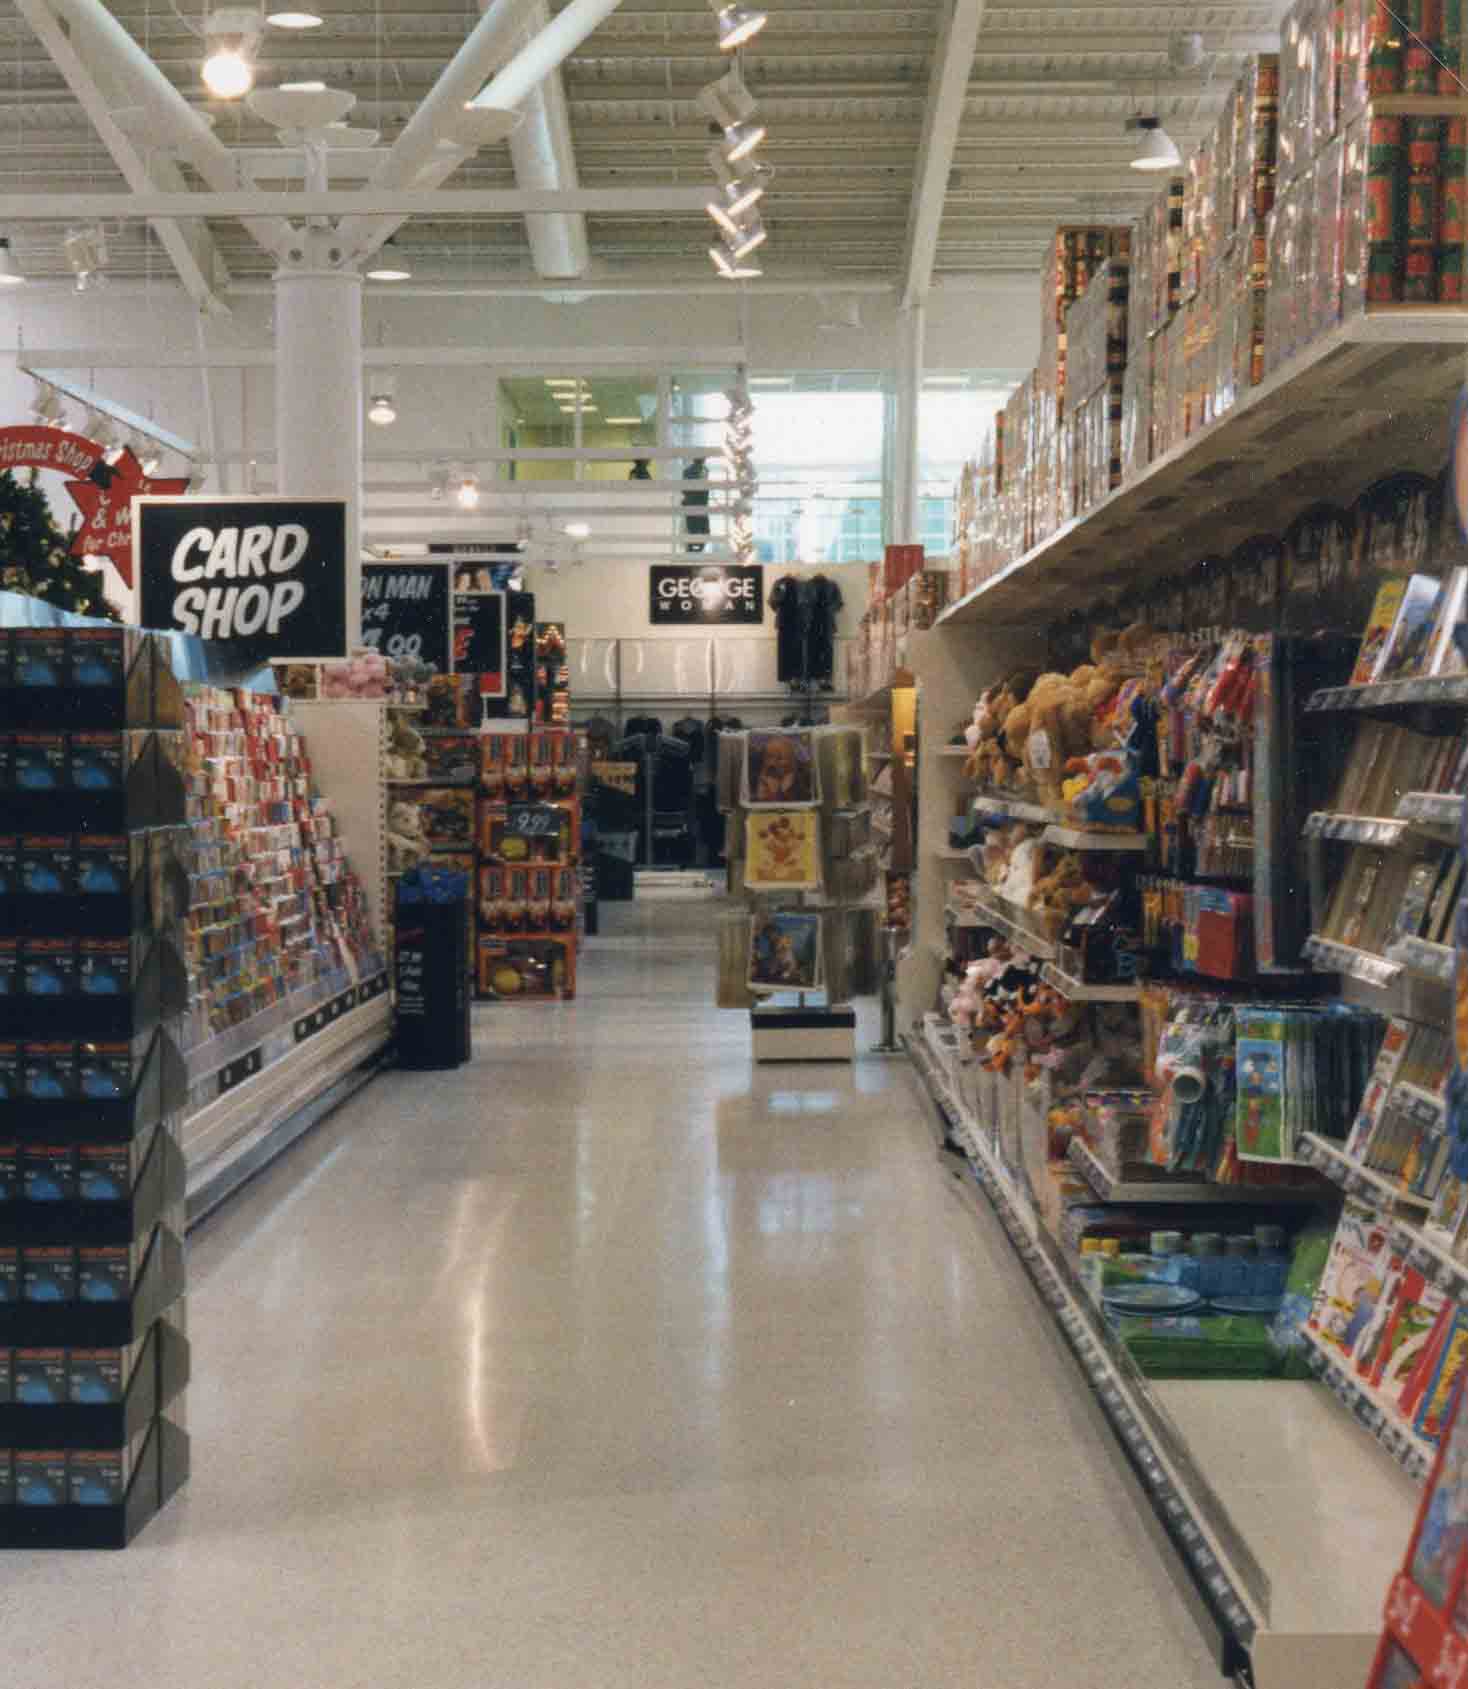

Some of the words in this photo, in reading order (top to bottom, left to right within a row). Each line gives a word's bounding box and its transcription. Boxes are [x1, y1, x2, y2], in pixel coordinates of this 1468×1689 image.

[171, 523, 310, 583] CARD
[384, 575, 433, 599] MAN
[658, 577, 755, 599] GEOGE
[172, 581, 305, 640] SHOP
[658, 600, 756, 611] WOAN
